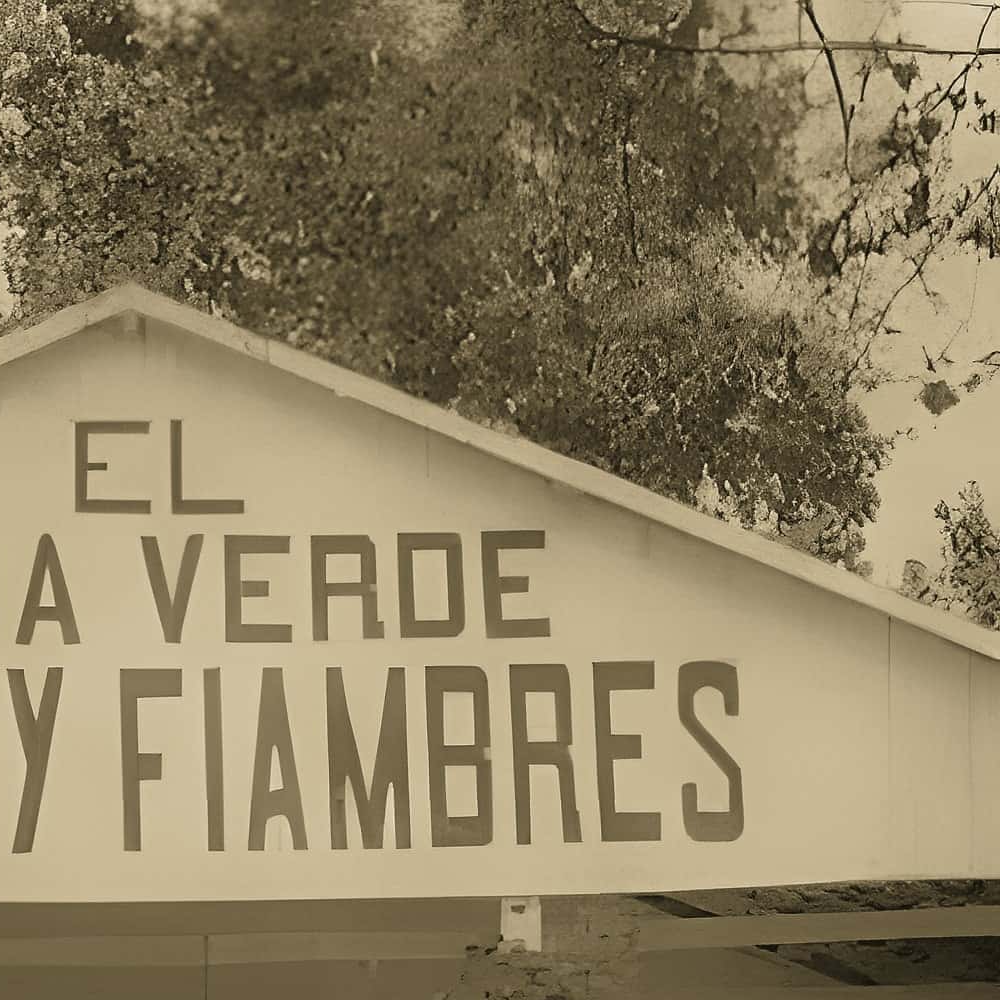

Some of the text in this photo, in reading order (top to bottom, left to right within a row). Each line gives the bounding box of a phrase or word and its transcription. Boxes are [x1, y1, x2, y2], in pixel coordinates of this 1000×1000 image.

[74, 420, 244, 515] EL
[140, 529, 551, 644] VERDE
[5, 666, 64, 855] Y
[119, 660, 745, 853] FIAMBRES
